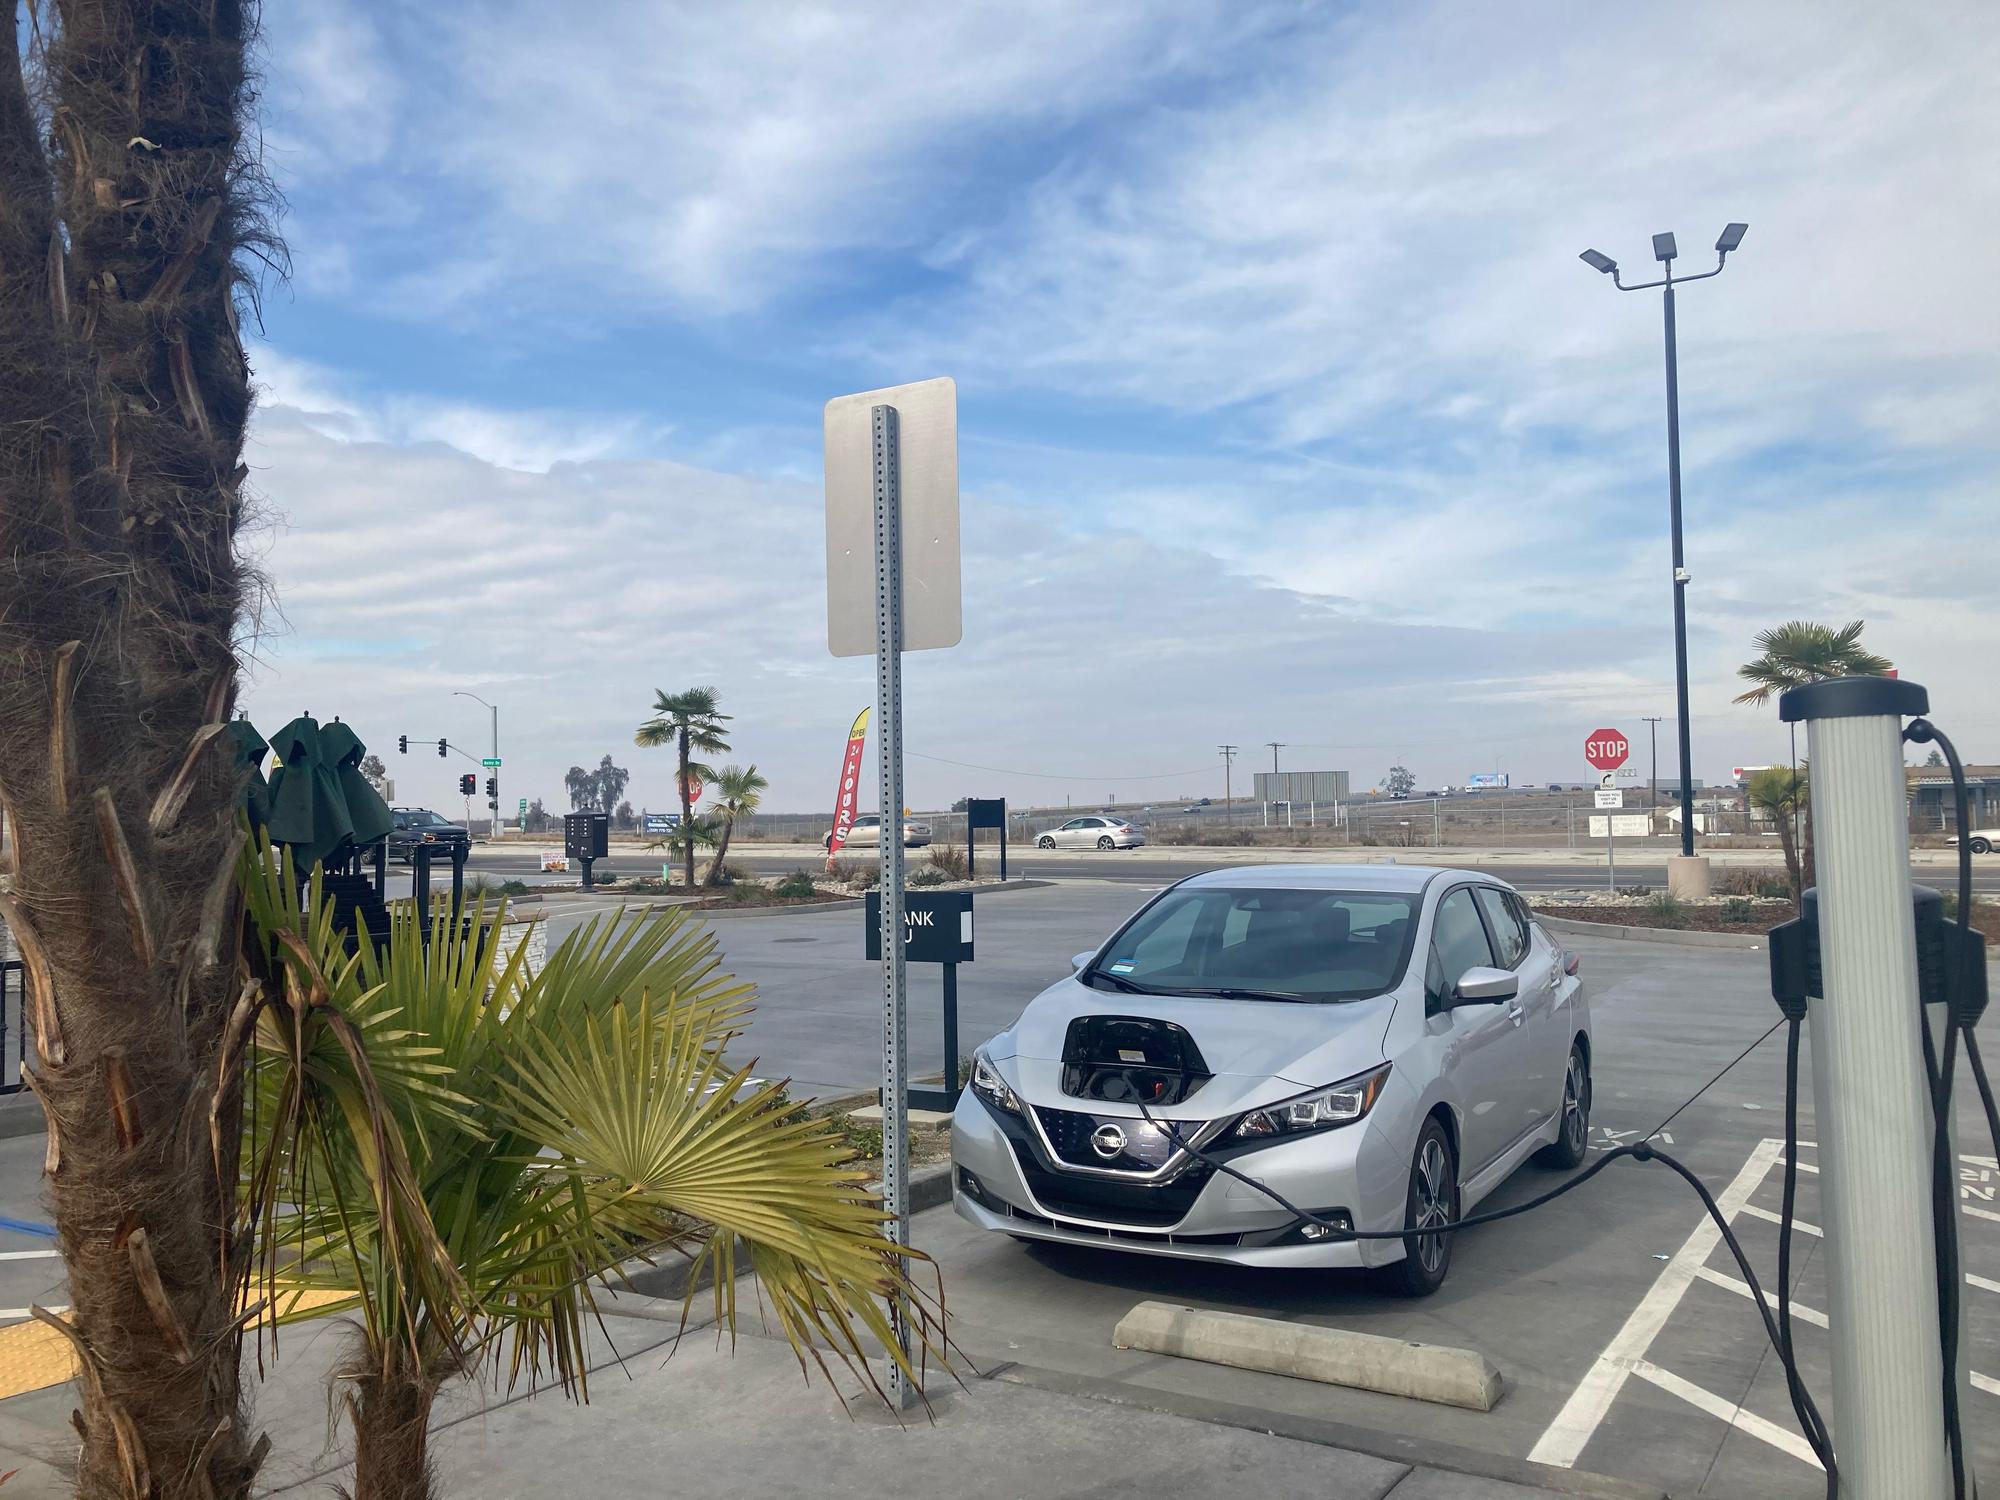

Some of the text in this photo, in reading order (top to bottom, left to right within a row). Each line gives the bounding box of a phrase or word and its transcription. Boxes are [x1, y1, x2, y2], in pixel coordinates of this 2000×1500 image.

[852, 728, 865, 738] OPE
[1587, 740, 1627, 759] STOP
[835, 761, 855, 842] HOURS
[1093, 1136, 1122, 1147] NISSAN
